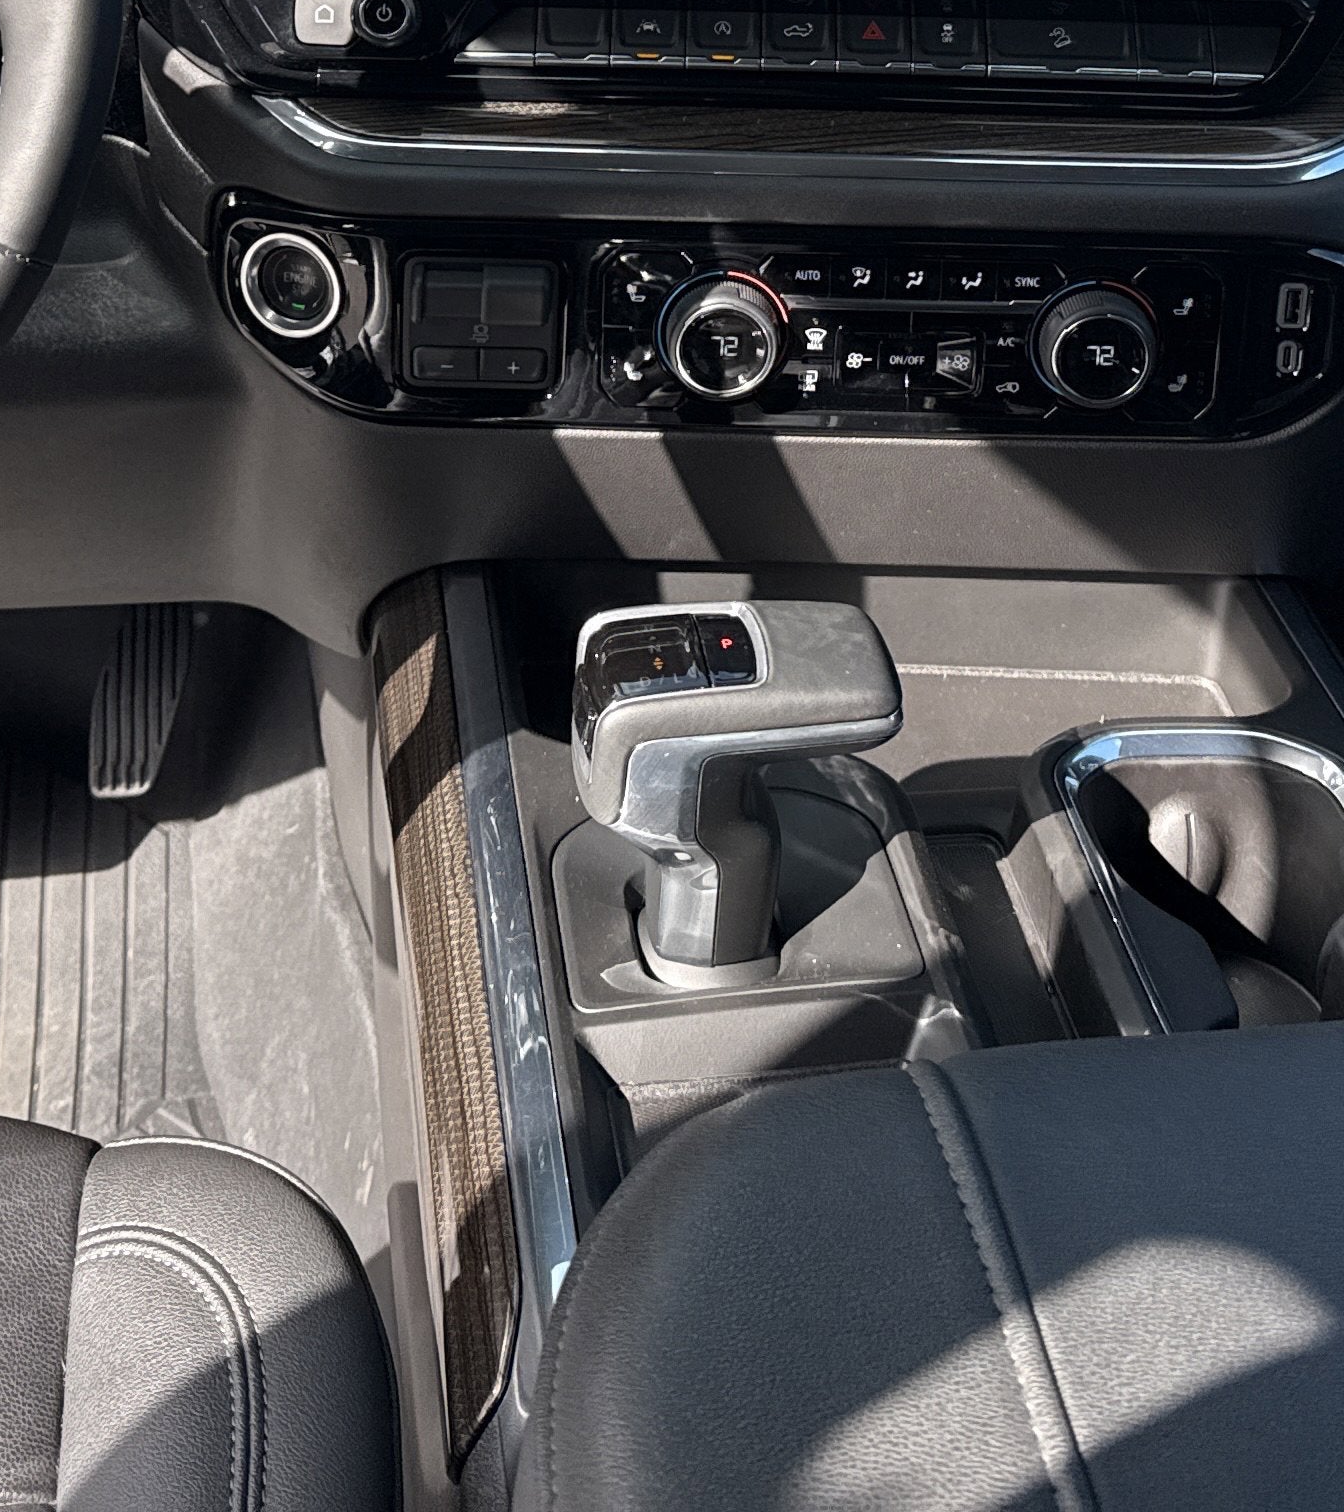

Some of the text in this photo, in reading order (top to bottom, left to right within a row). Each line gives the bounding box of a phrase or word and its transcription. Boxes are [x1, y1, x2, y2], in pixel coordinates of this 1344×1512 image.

[794, 269, 821, 281] AUTO
[1014, 276, 1041, 287] SYNC
[710, 335, 739, 357] 72
[997, 337, 1015, 347] A/C
[889, 355, 926, 365] ON/OFF
[1086, 345, 1115, 366] 72
[720, 638, 733, 649] P
